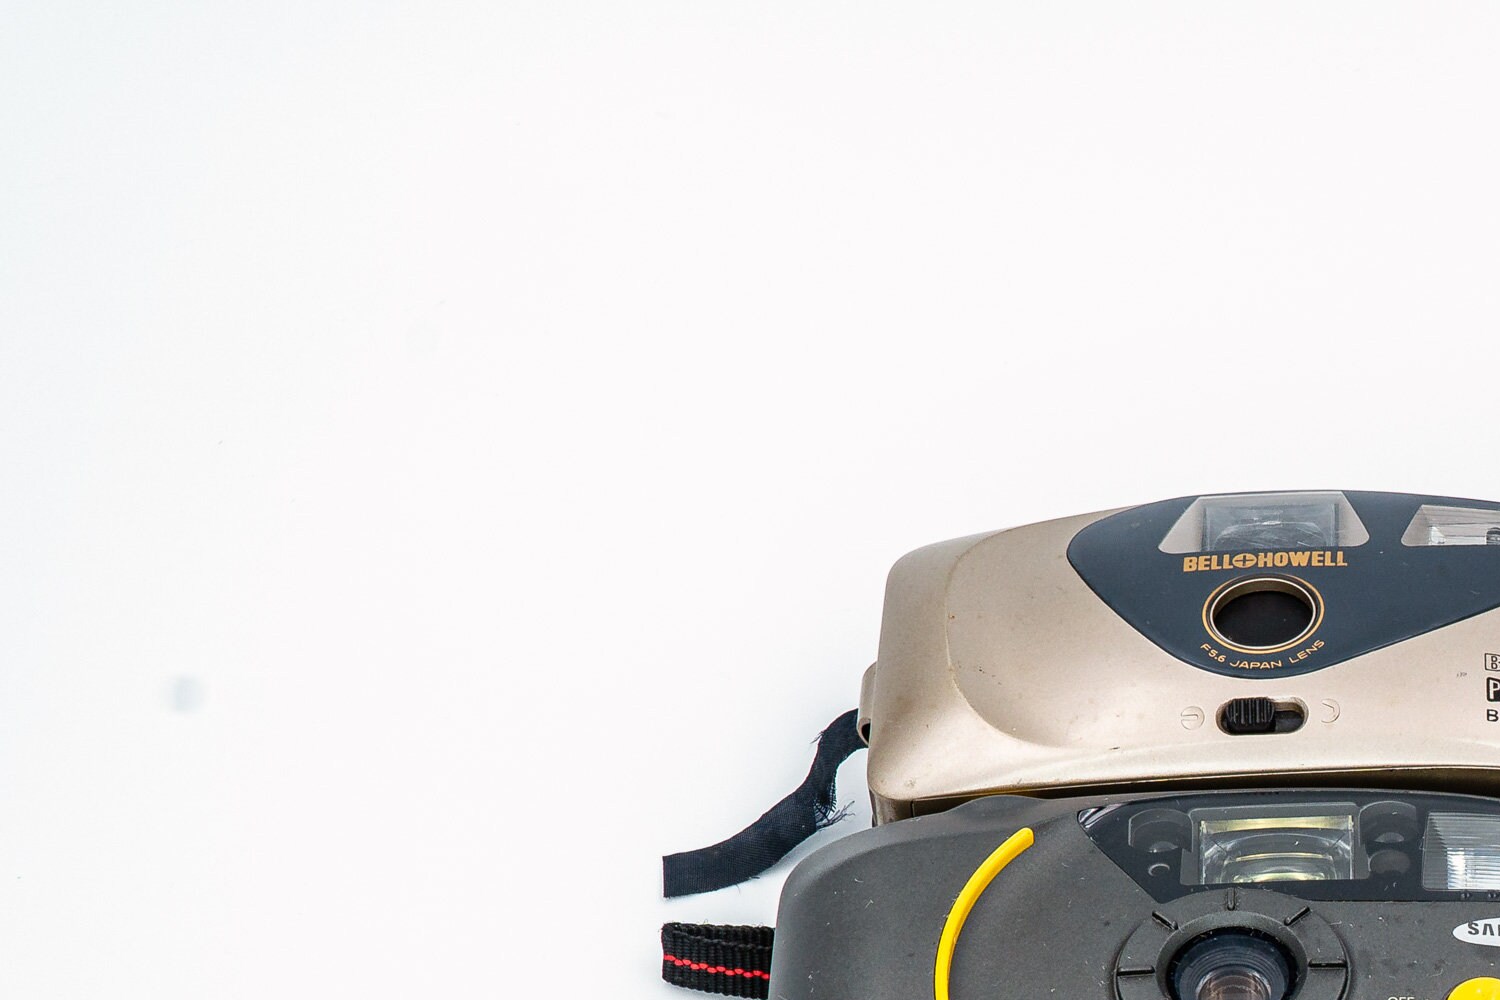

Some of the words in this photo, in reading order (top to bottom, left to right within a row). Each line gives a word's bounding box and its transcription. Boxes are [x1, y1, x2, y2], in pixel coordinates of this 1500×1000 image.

[1200, 643, 1226, 663] F5.6
[1230, 660, 1282, 669] JAPAN
[1289, 639, 1325, 664] LENS
